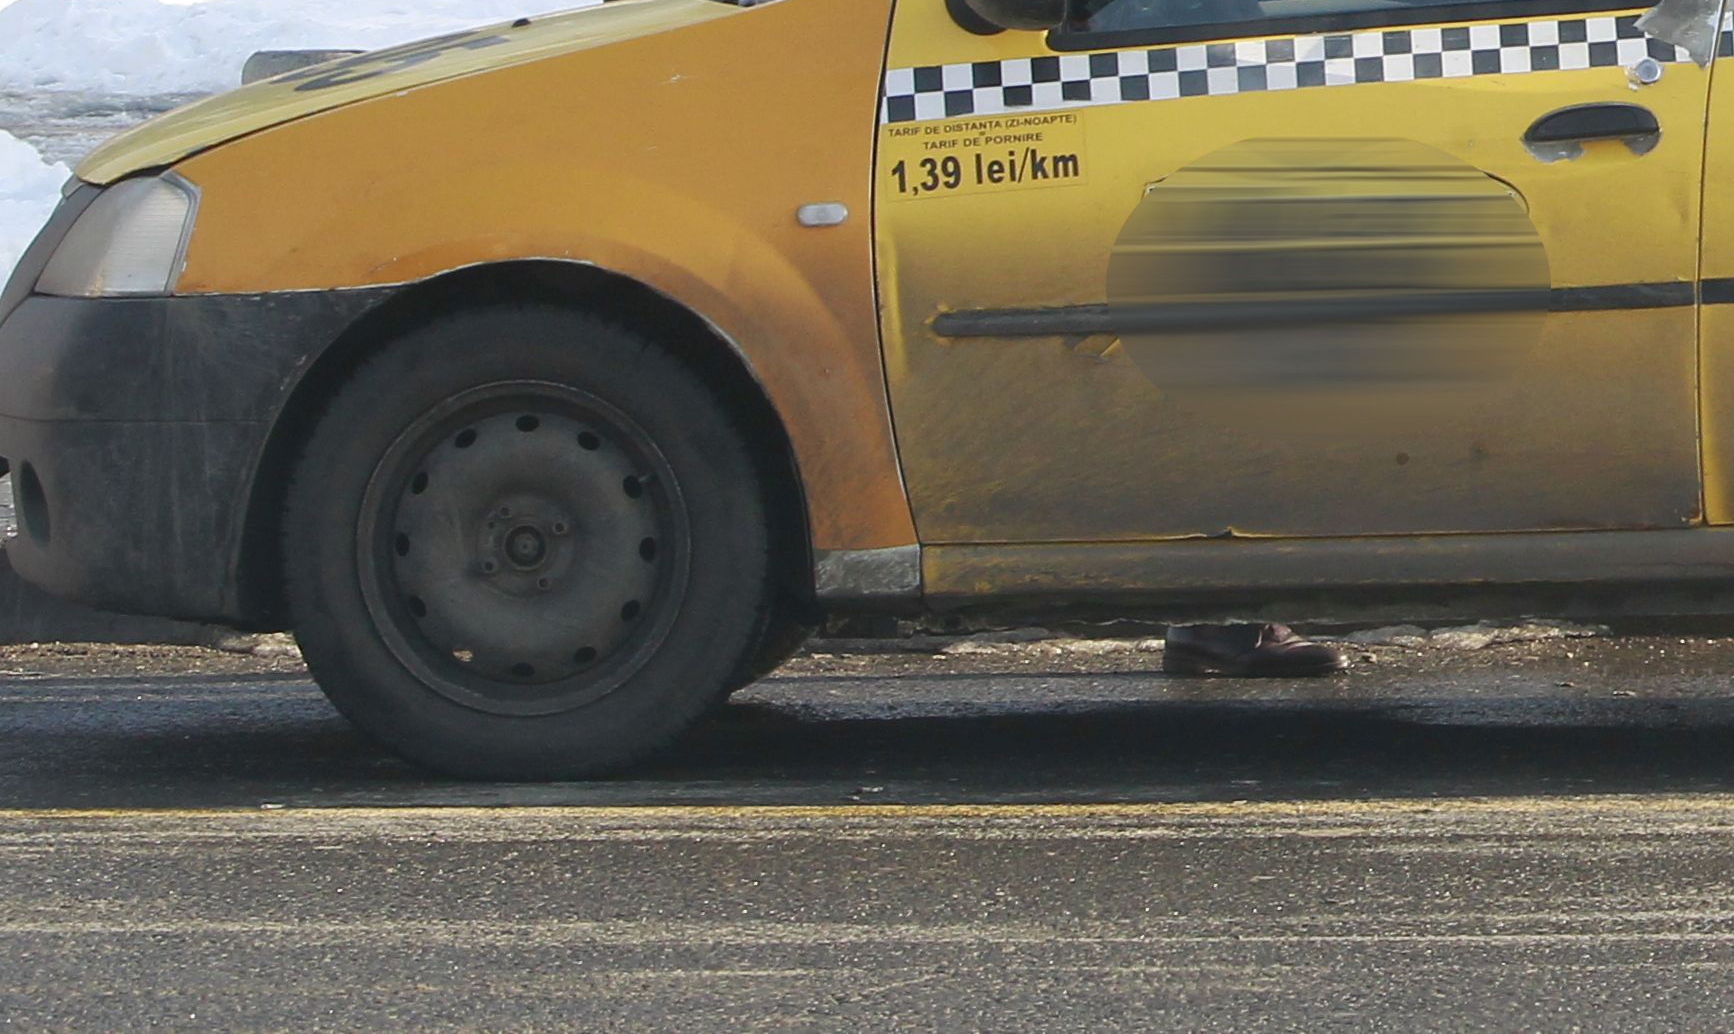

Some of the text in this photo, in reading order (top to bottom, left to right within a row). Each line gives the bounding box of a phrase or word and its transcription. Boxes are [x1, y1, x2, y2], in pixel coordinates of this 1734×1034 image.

[888, 126, 920, 137] TARIF
[924, 126, 940, 135] DE
[1005, 114, 1077, 128] (ZI-NOAPTE)
[922, 139, 958, 150] TARIF
[963, 137, 980, 147] DE
[985, 132, 1043, 145] PORNIRE
[891, 147, 1079, 196] 1,39 lei/km
